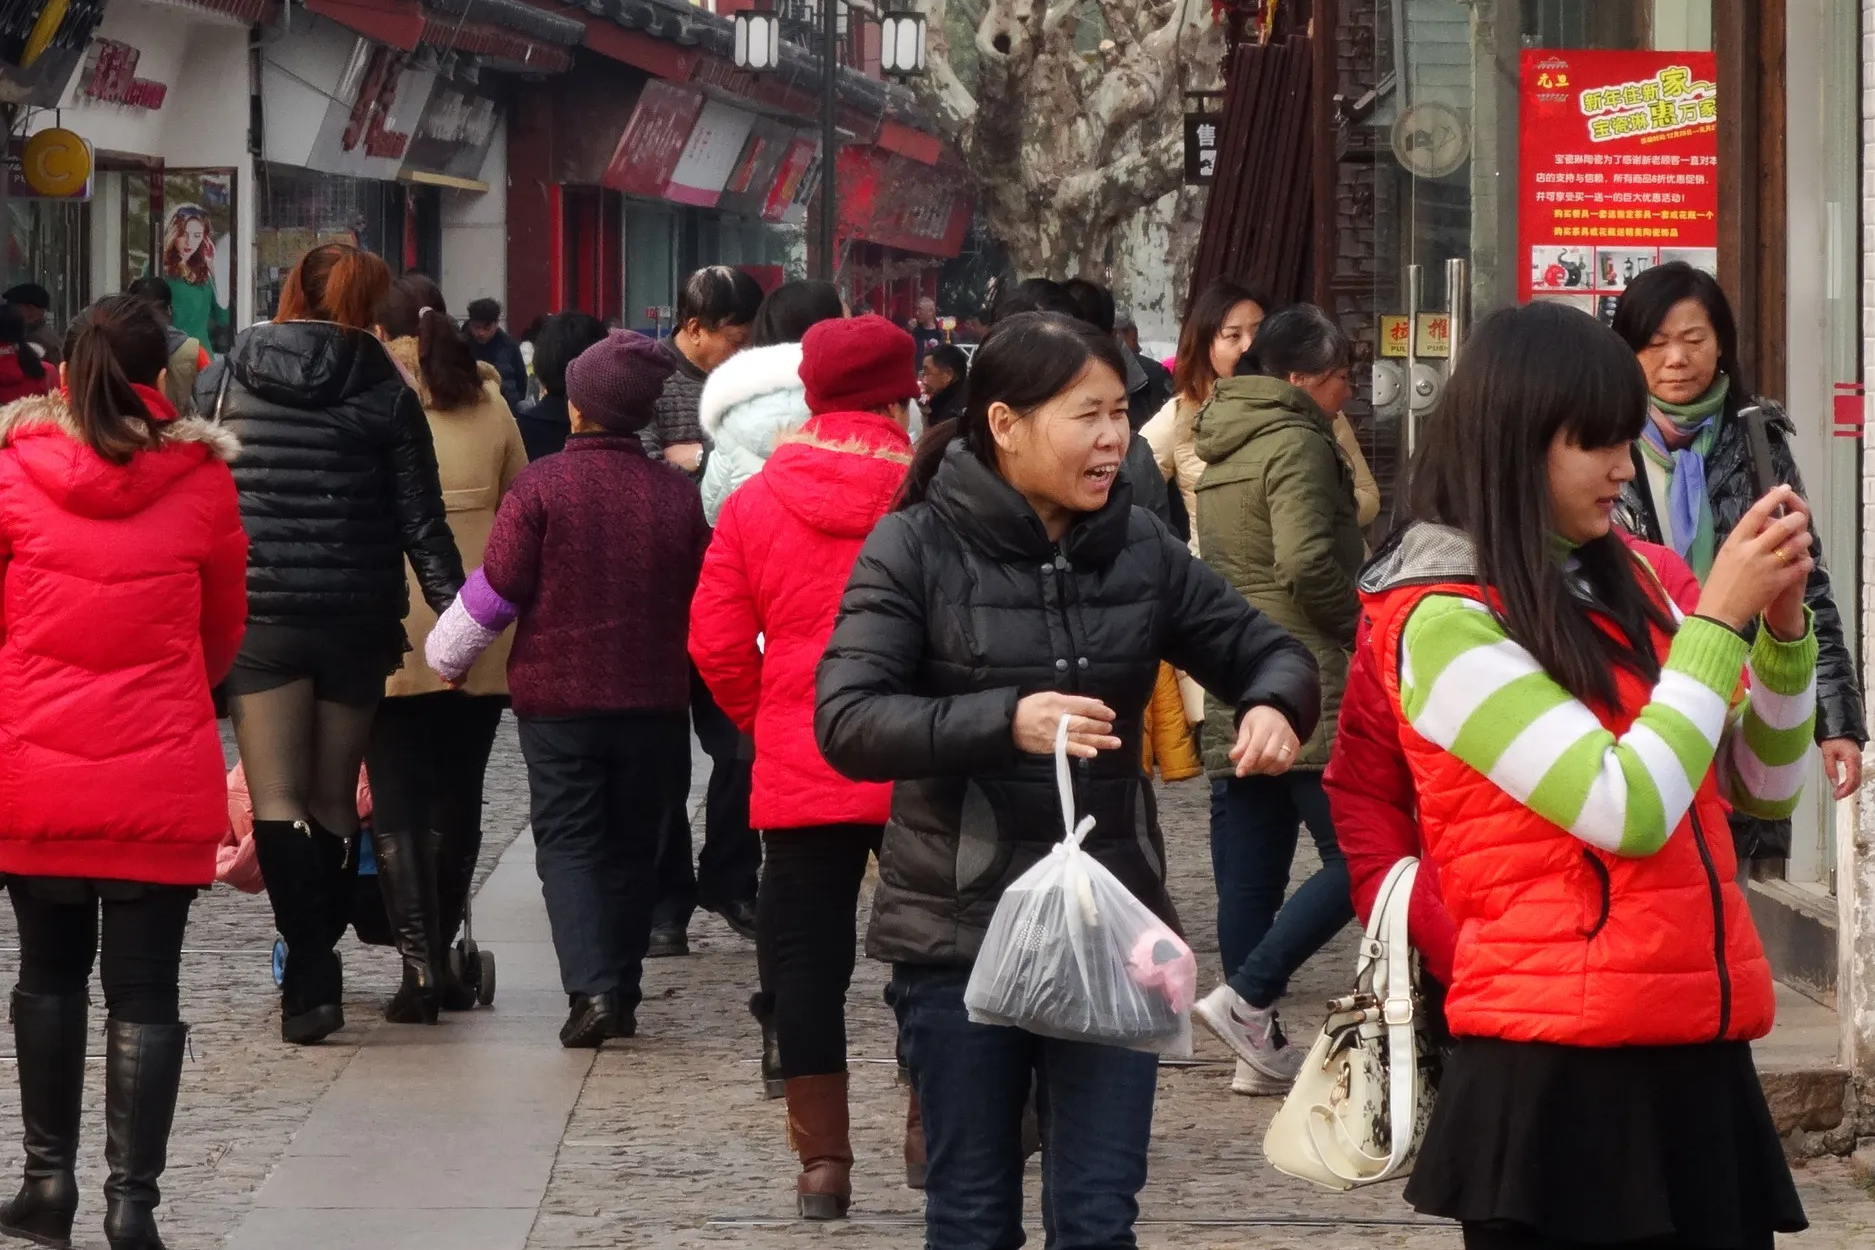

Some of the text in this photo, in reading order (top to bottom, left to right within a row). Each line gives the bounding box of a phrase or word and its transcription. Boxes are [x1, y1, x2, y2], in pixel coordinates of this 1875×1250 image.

[1537, 73, 1570, 88] 元旦
[1583, 67, 1690, 113] 新年住新家
[1591, 97, 1717, 139] 宝瓷琳惠万家
[37, 145, 71, 181] C
[1390, 321, 1408, 341] 拉
[1427, 317, 1448, 341] 推
